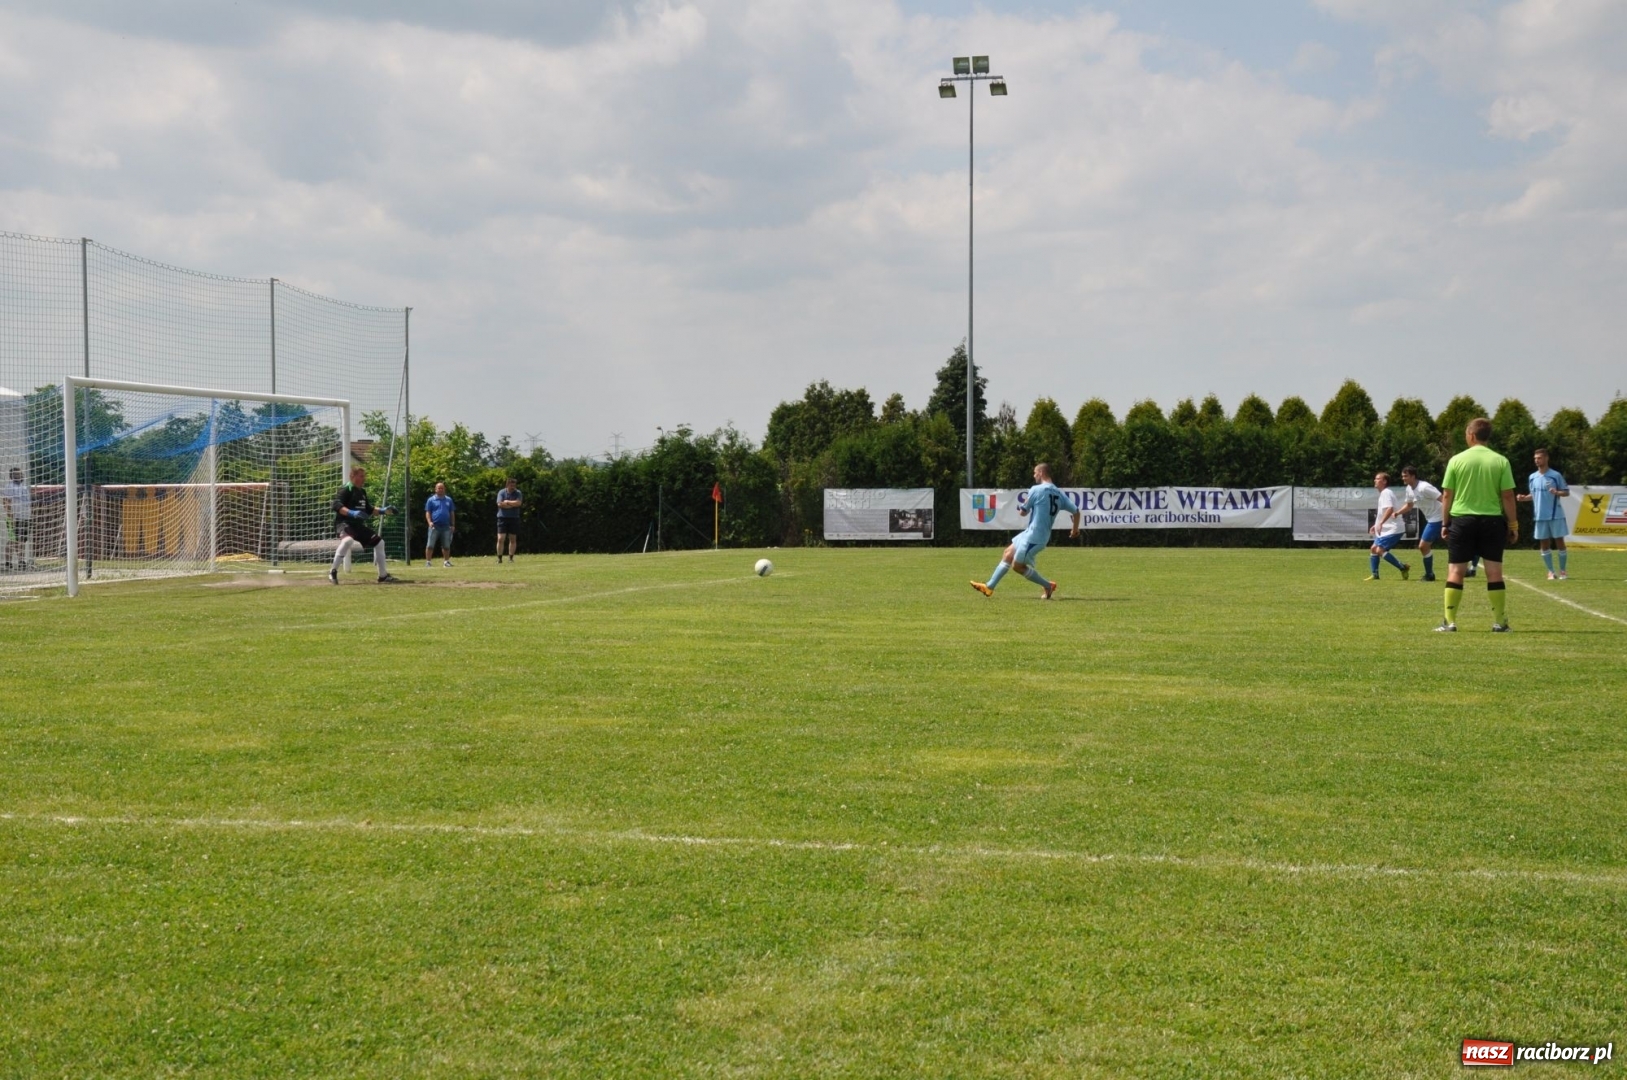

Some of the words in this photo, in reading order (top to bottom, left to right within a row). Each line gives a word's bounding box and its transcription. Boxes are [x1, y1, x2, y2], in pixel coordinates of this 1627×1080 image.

[1017, 490, 1169, 511] SDECZNIE
[1176, 489, 1278, 511] WITAMY
[1297, 488, 1364, 500] ELEKTRO
[1048, 493, 1060, 517] 15
[1083, 512, 1141, 527] powiecie
[1144, 511, 1221, 524] raciborskim
